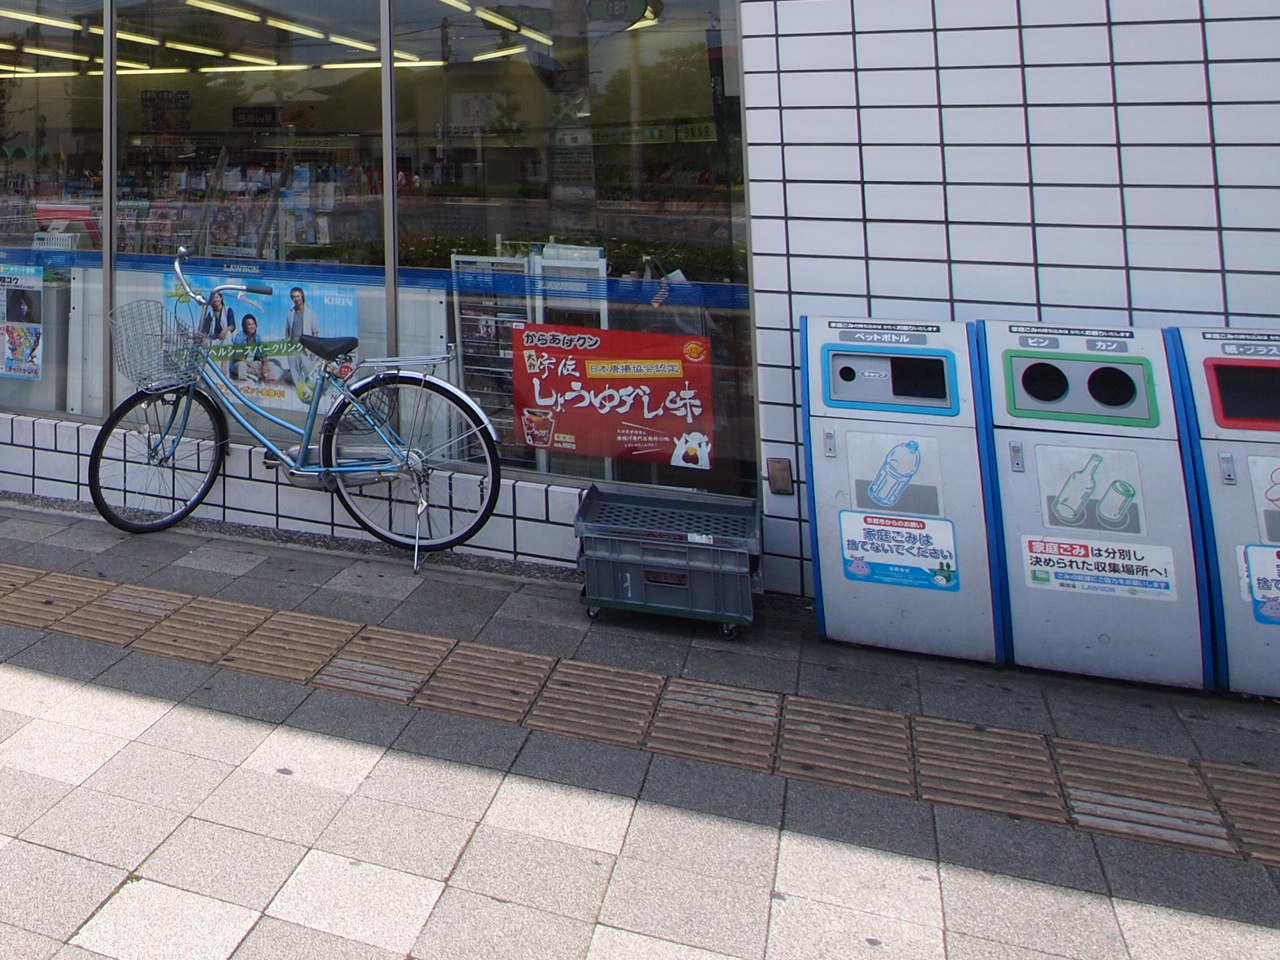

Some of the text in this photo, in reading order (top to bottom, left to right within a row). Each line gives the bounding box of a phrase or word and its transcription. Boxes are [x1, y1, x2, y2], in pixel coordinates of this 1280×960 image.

[223, 263, 260, 273] LAWSON
[324, 296, 353, 307] KIRIN
[523, 331, 600, 349] からあげクン
[854, 331, 910, 343] ペットボトル
[1095, 341, 1117, 350] カン
[533, 376, 703, 424] しょうゆだし味
[863, 527, 934, 546] 家庭ごみは
[846, 539, 954, 560] 捨てないでください
